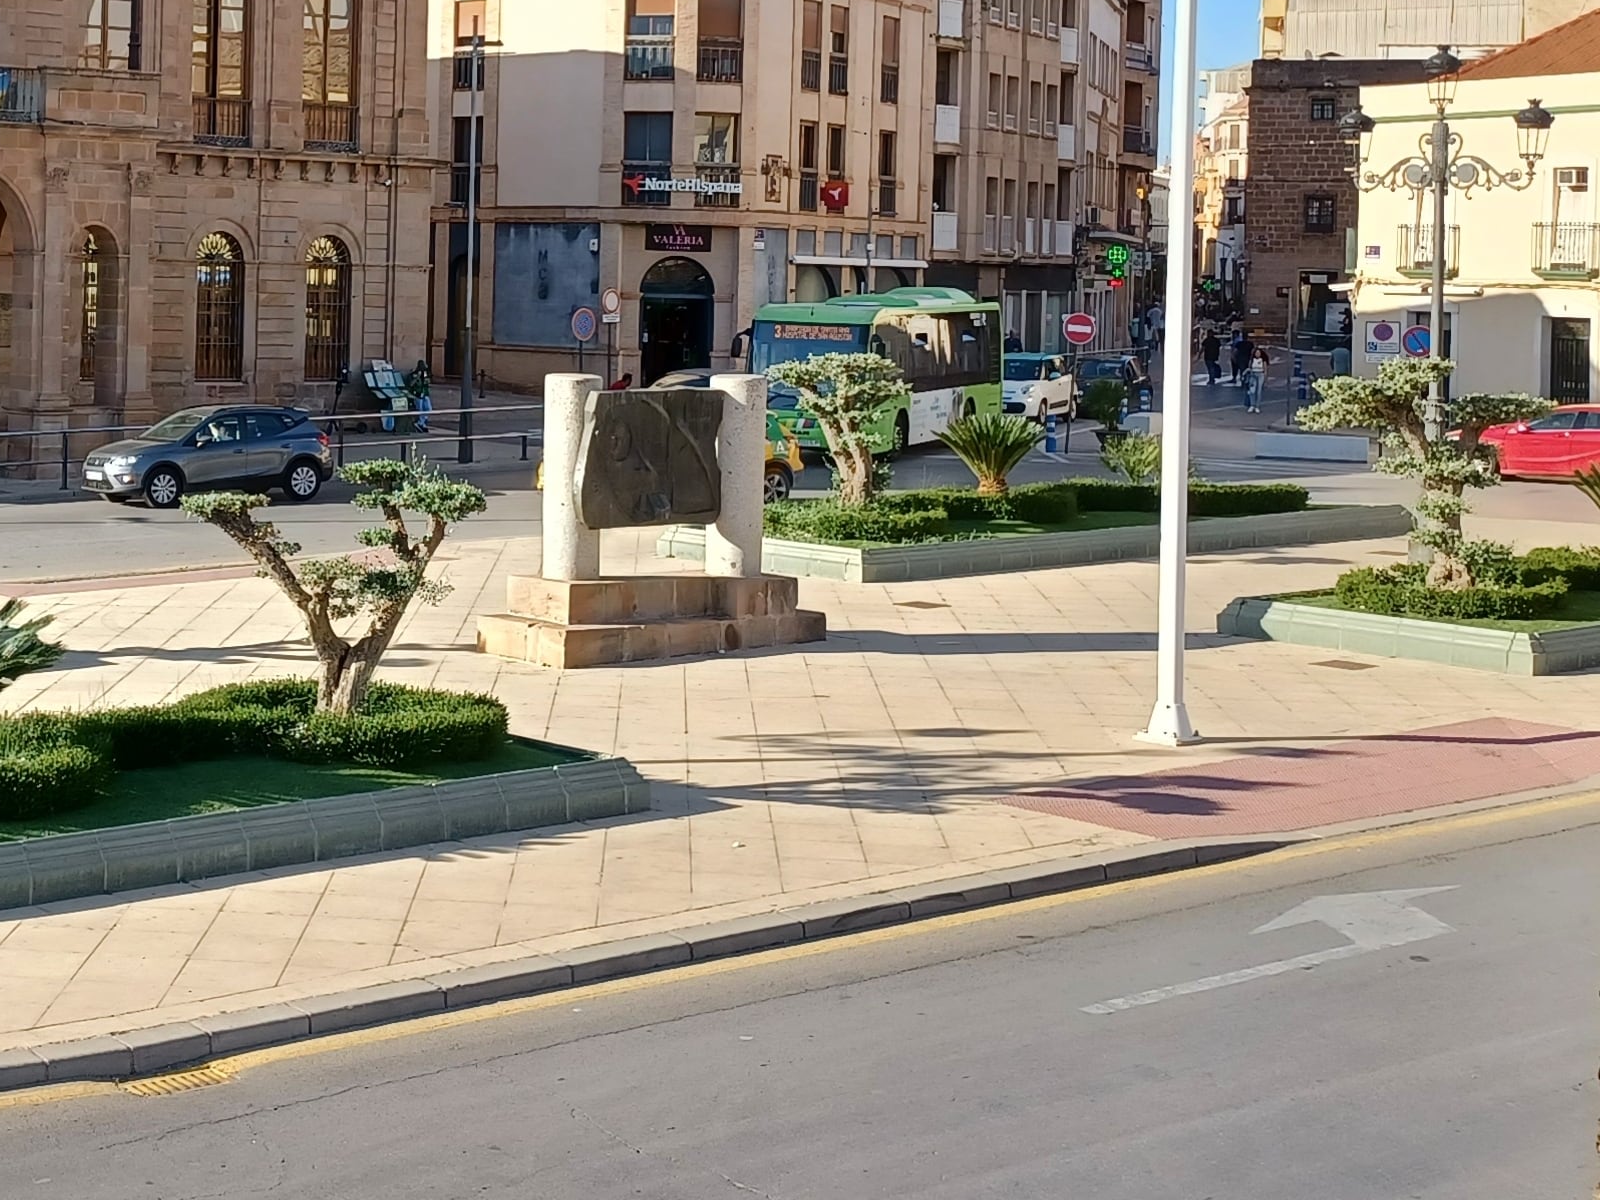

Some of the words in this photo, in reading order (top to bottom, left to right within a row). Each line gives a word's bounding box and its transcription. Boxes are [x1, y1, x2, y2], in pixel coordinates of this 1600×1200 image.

[645, 177, 742, 195] NorteHispana
[652, 235, 704, 246] VALERIA
[774, 325, 782, 338] 3
